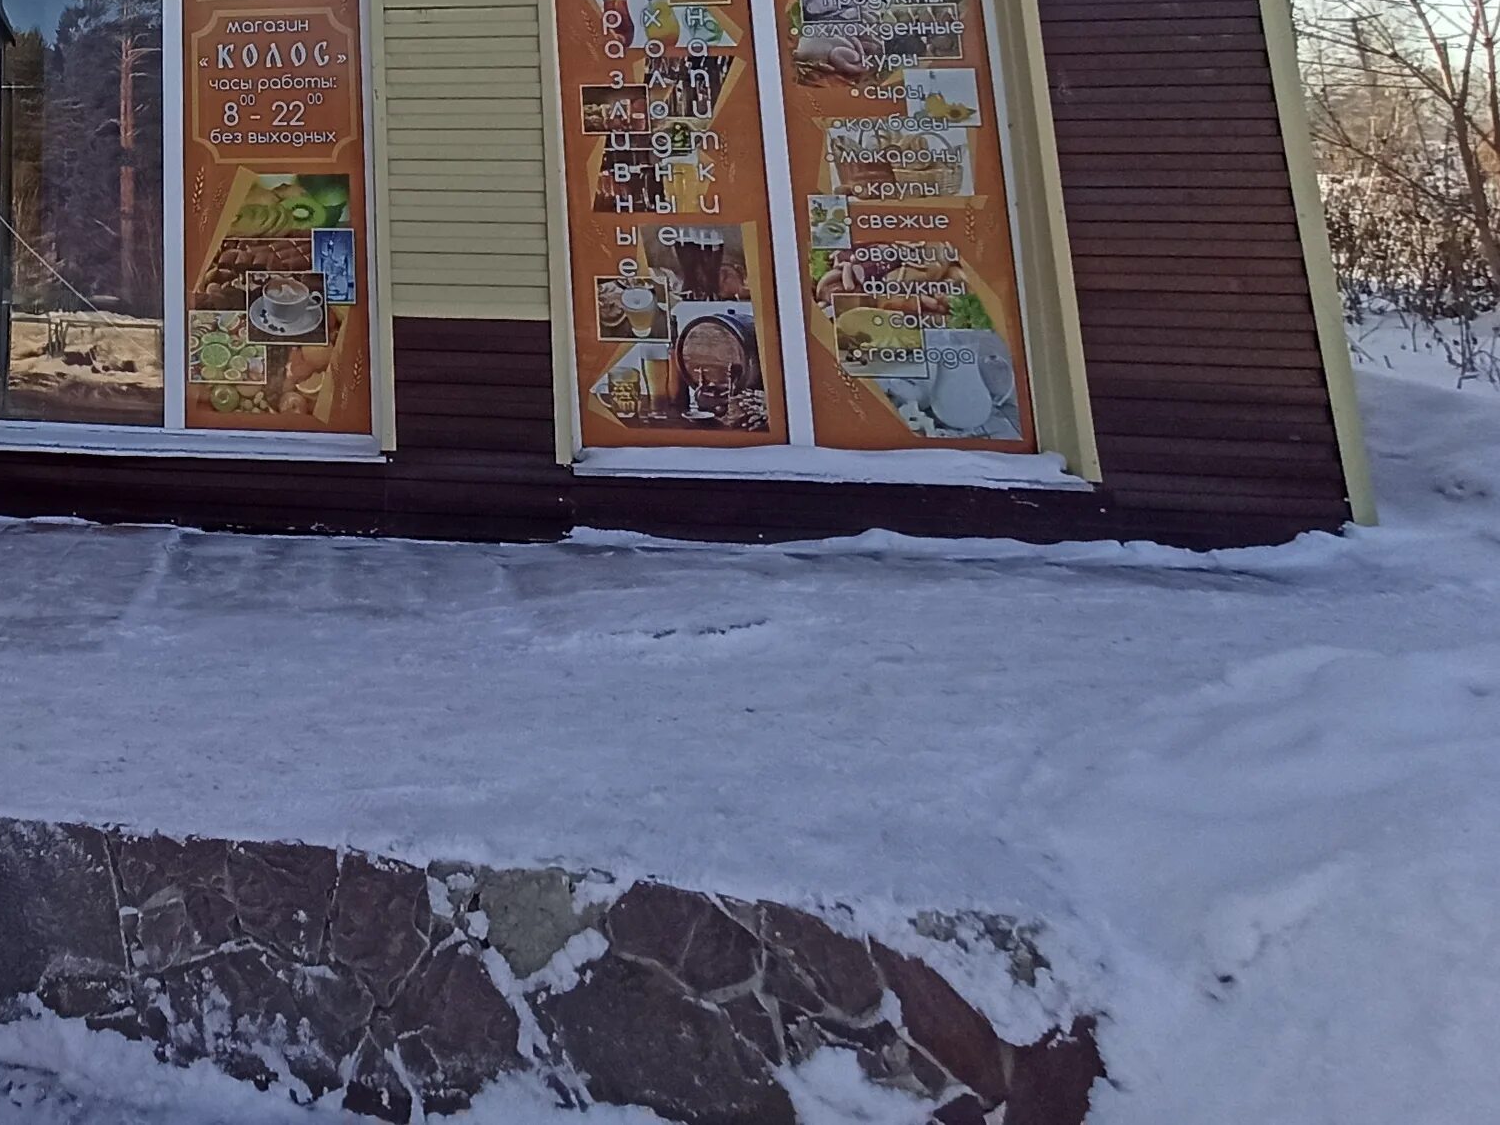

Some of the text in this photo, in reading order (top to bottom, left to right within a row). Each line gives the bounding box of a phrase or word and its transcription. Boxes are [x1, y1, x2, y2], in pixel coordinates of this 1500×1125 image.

[226, 19, 309, 33] магазин
[802, 21, 965, 40] охлажденные
[861, 53, 918, 72] куры
[208, 74, 337, 93] часы работы:
[863, 84, 923, 102] сыры
[845, 113, 949, 131] колбасы
[209, 128, 336, 147] без выходных
[840, 148, 962, 167] макароны
[867, 181, 939, 200] крупы
[856, 214, 950, 230] свежие
[854, 246, 960, 266] овощи и
[862, 276, 966, 299] фрукты
[889, 313, 946, 329] соки
